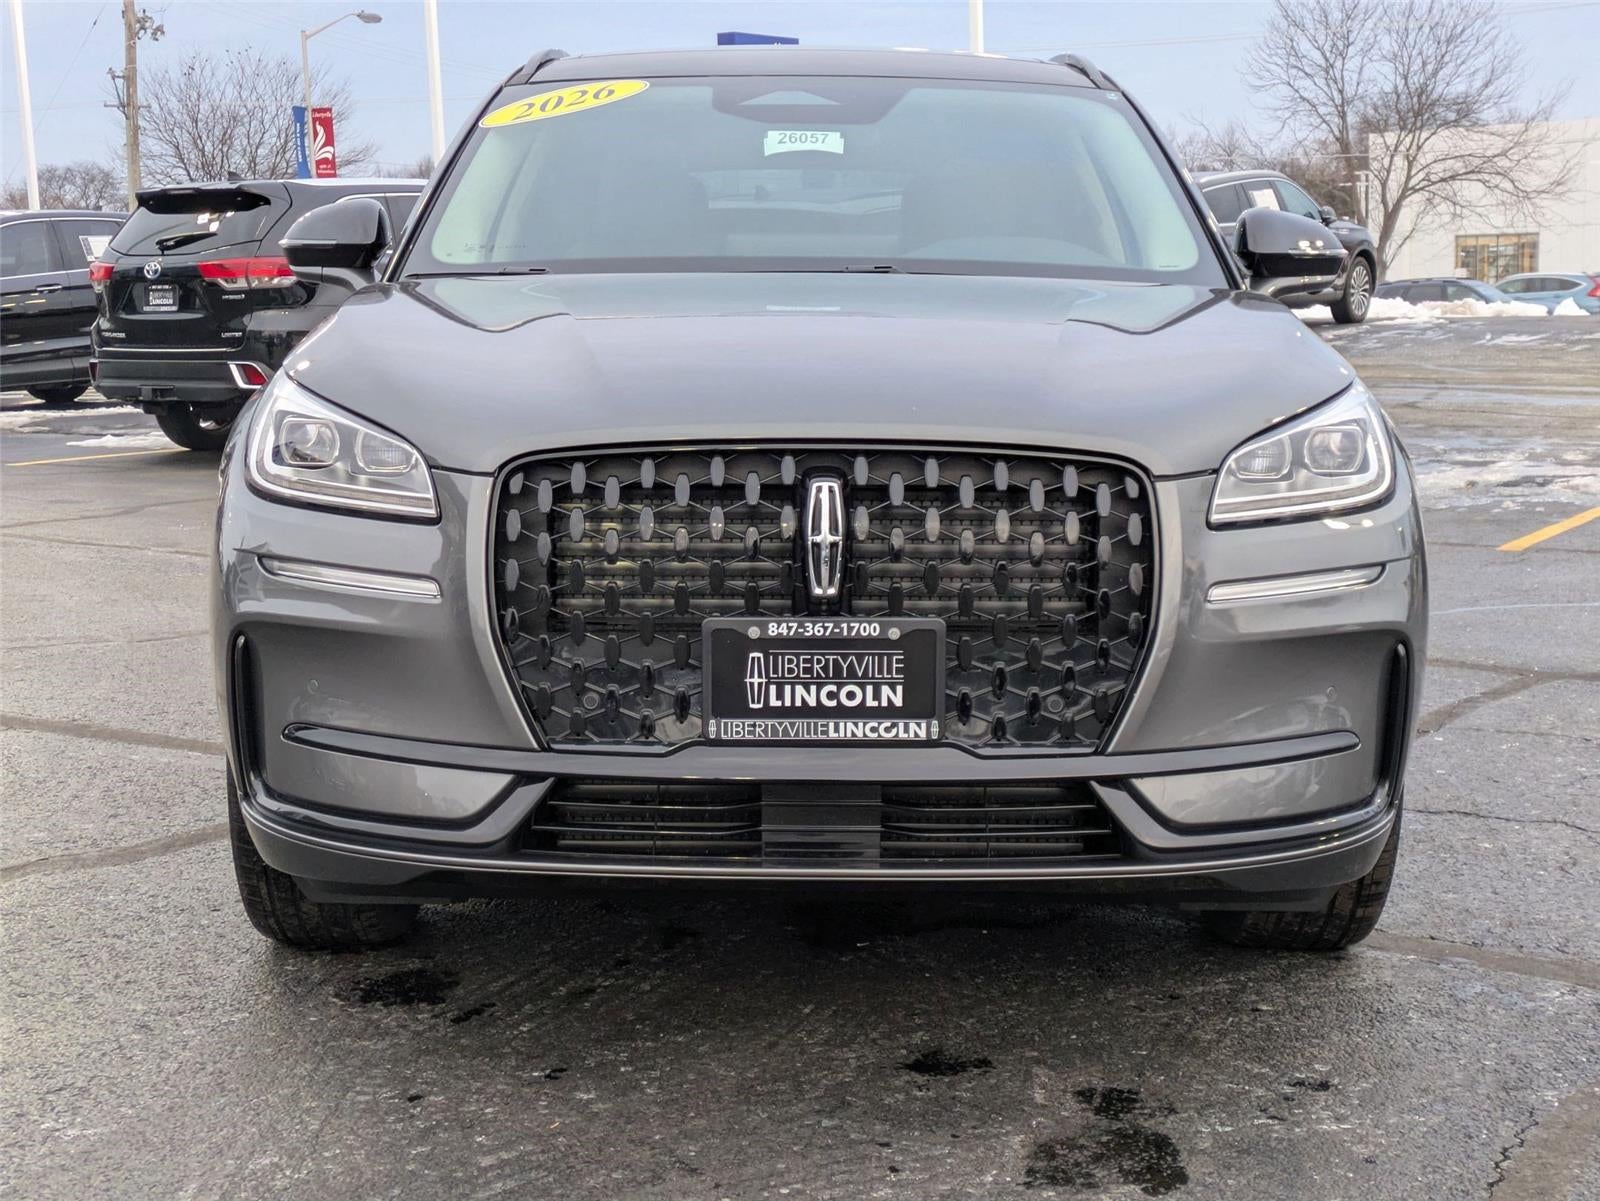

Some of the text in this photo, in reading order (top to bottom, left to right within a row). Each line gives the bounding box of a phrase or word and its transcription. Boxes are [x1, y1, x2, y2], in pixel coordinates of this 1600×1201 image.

[511, 84, 616, 121] 2026
[777, 132, 829, 144] 26057
[768, 623, 880, 636] 847-367-1700
[769, 655, 904, 678] LIBERTYVILLE
[769, 685, 903, 707] LINCOLN
